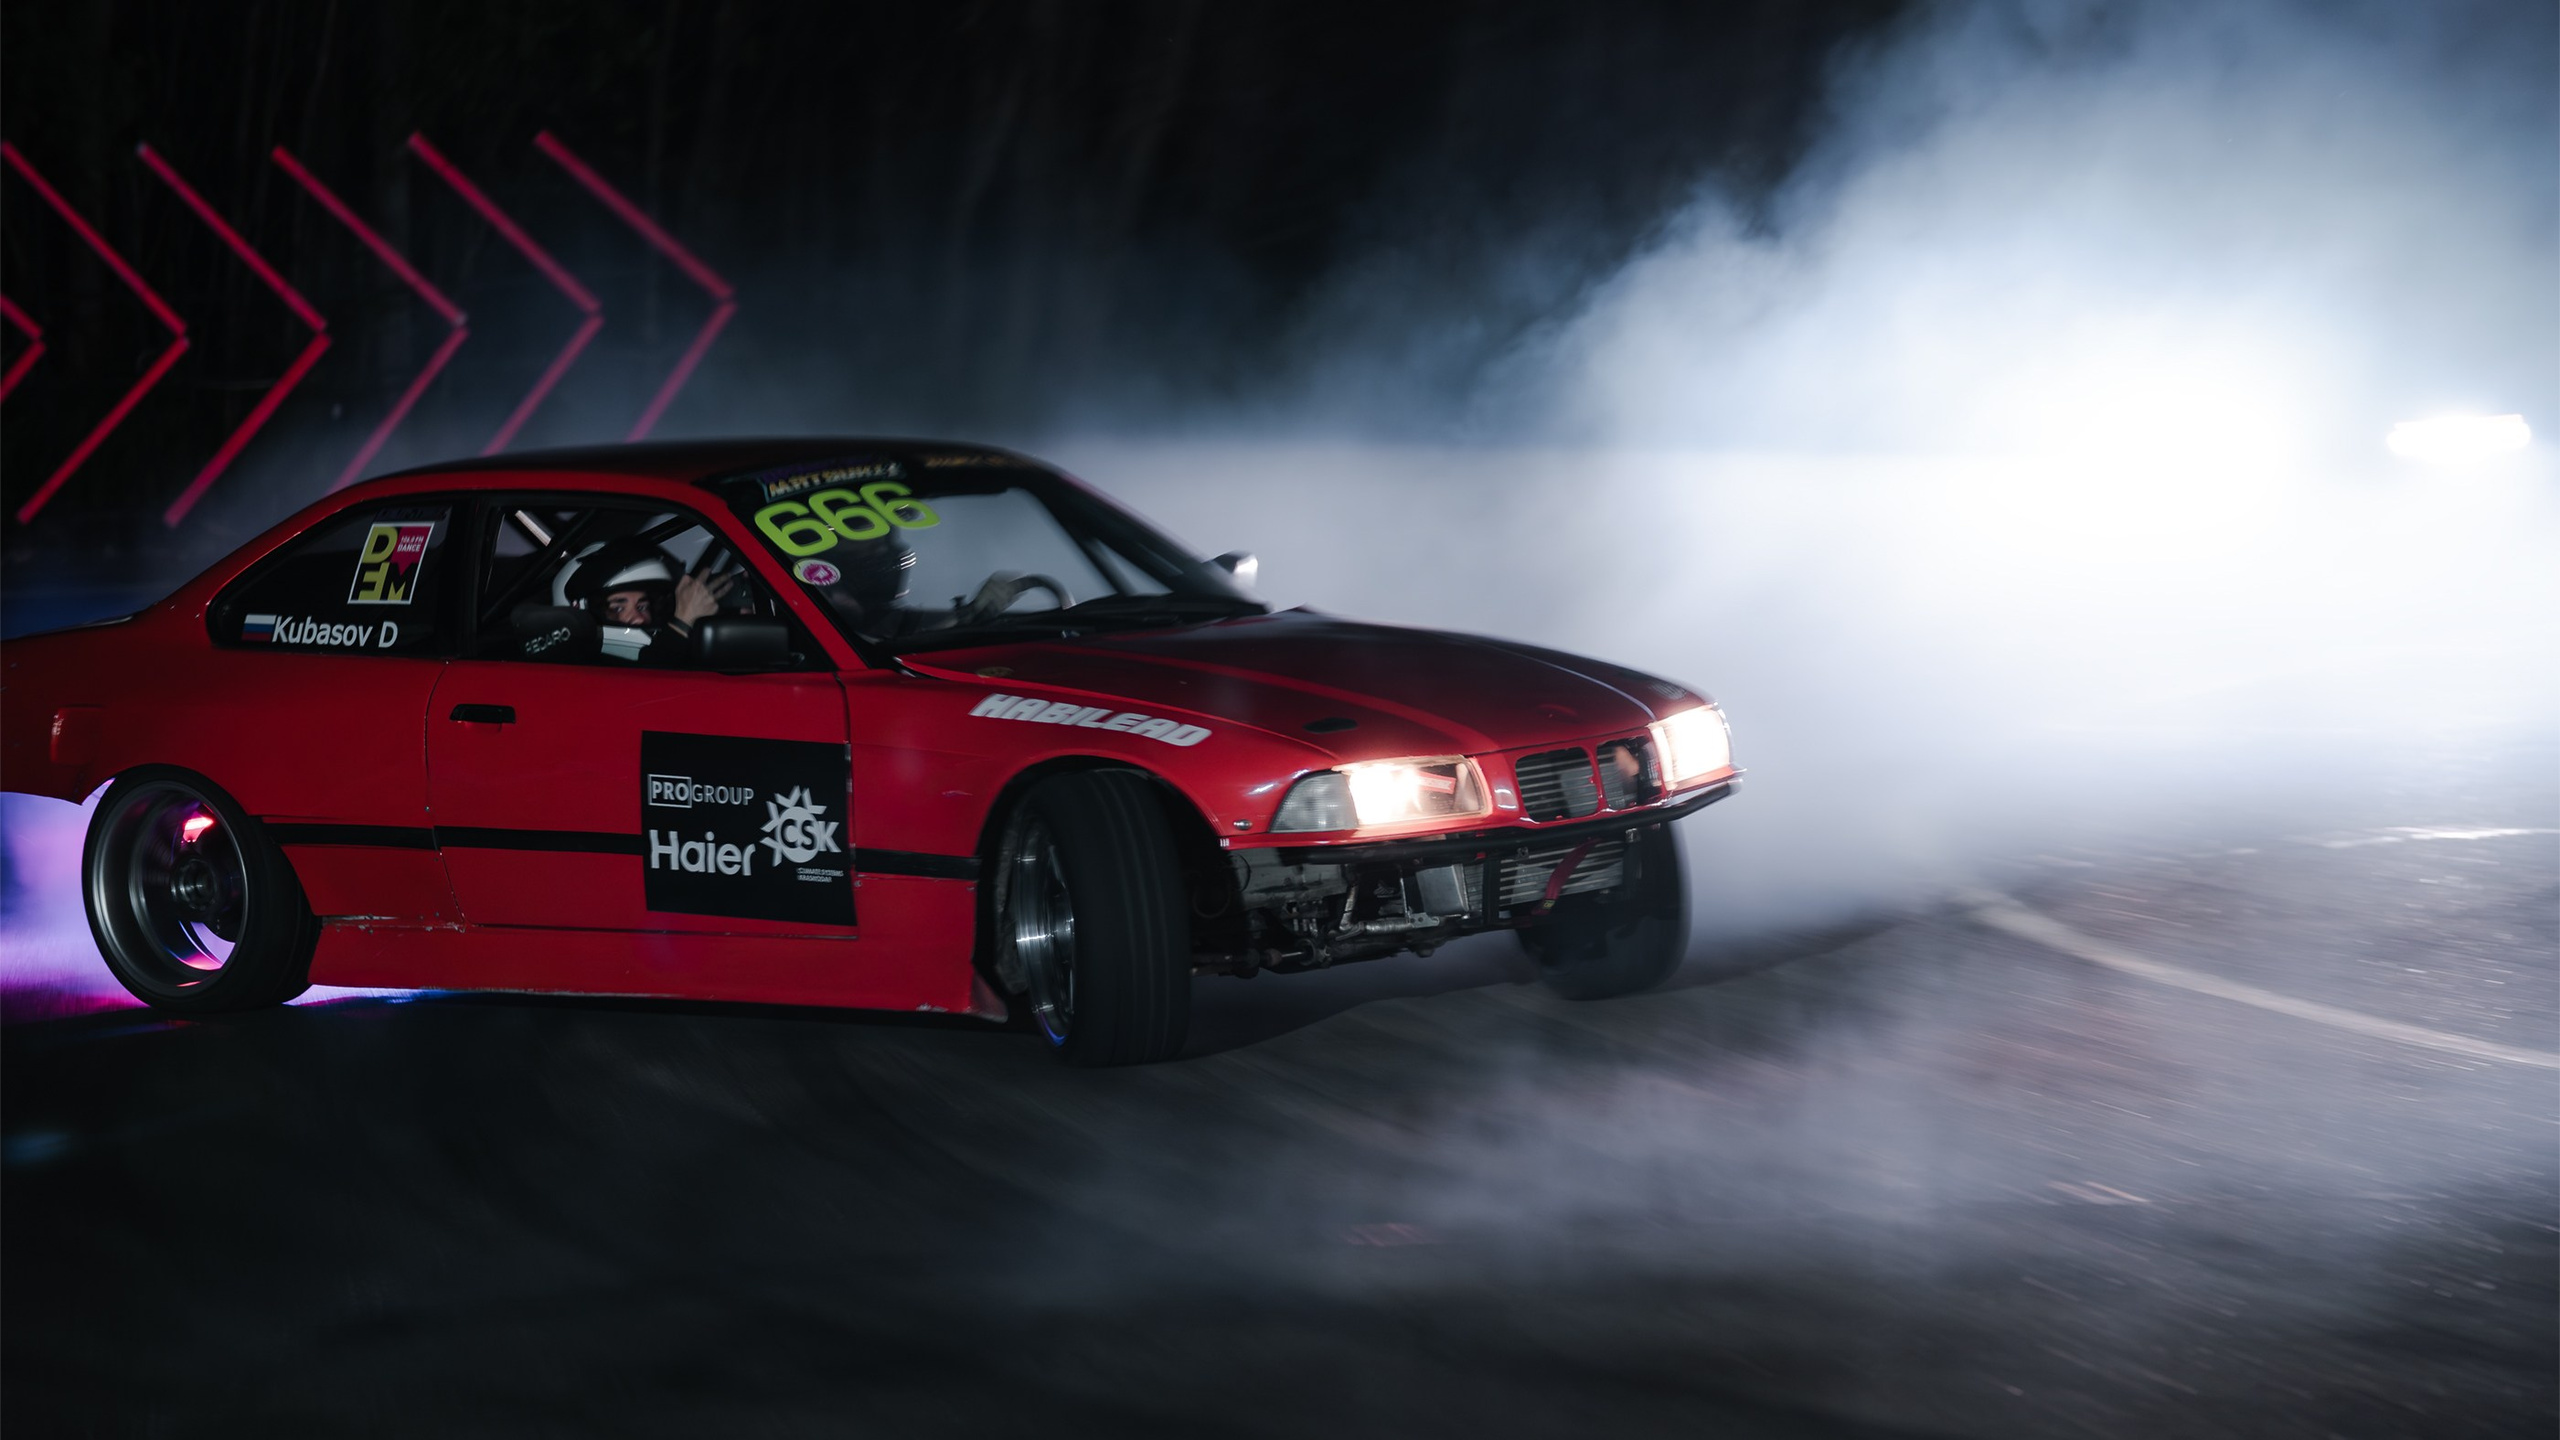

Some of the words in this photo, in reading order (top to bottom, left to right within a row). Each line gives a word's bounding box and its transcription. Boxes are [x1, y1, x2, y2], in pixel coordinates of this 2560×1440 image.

[754, 480, 940, 557] 666
[397, 544, 421, 552] DANCE
[271, 614, 373, 647] Kubasov
[378, 620, 399, 648] D
[968, 692, 1213, 747] HABILEAD
[649, 828, 756, 876] Haier
[781, 818, 841, 853] CSK
